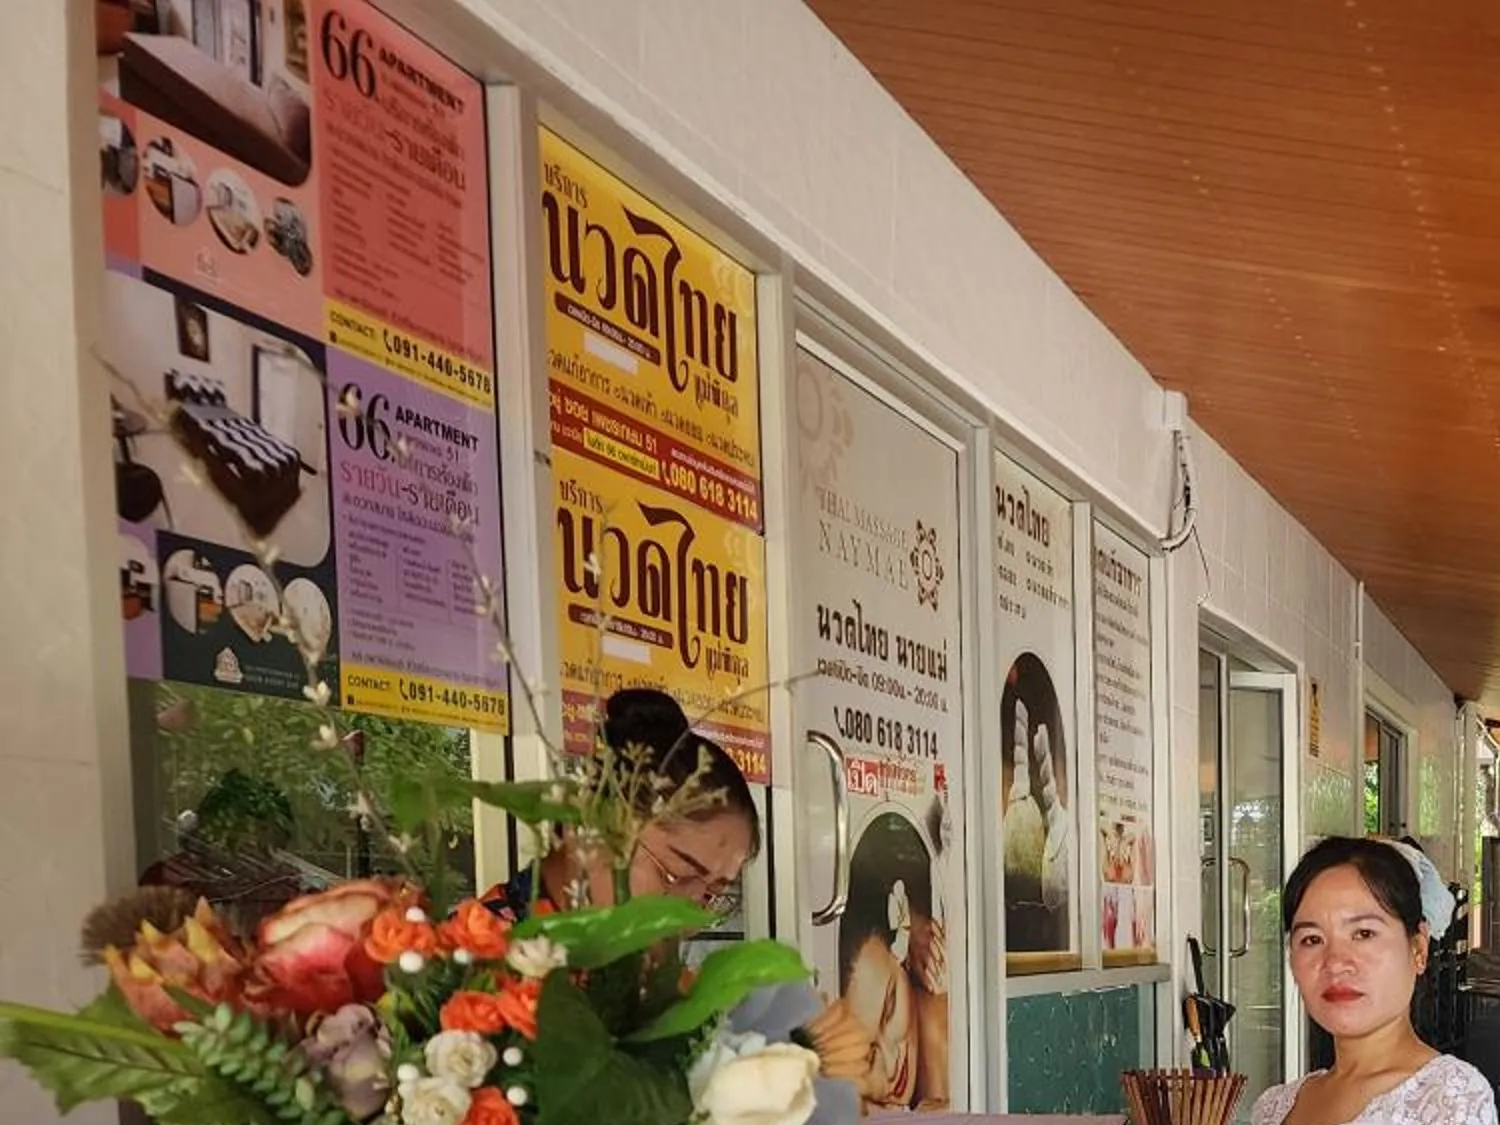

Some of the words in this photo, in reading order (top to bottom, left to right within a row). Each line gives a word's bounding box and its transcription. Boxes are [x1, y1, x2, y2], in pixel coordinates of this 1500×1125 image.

[378, 46, 465, 115] APARTMENT
[543, 162, 588, 209] บริการ
[541, 190, 738, 394] นวดไทย
[394, 336, 492, 394] 091-440-5678
[395, 405, 480, 452] APARTMENT
[559, 479, 603, 514] บริการ
[699, 475, 725, 508] 618
[727, 486, 759, 521] 3114
[995, 484, 1050, 549] นวดไทย
[556, 501, 749, 670] นวดไทย
[817, 598, 889, 661] นวดไทย
[896, 635, 948, 682] นายแม่
[408, 685, 507, 716] 091-440-5678
[843, 707, 873, 744] 080
[877, 716, 903, 751] 618
[907, 725, 938, 760] 3114
